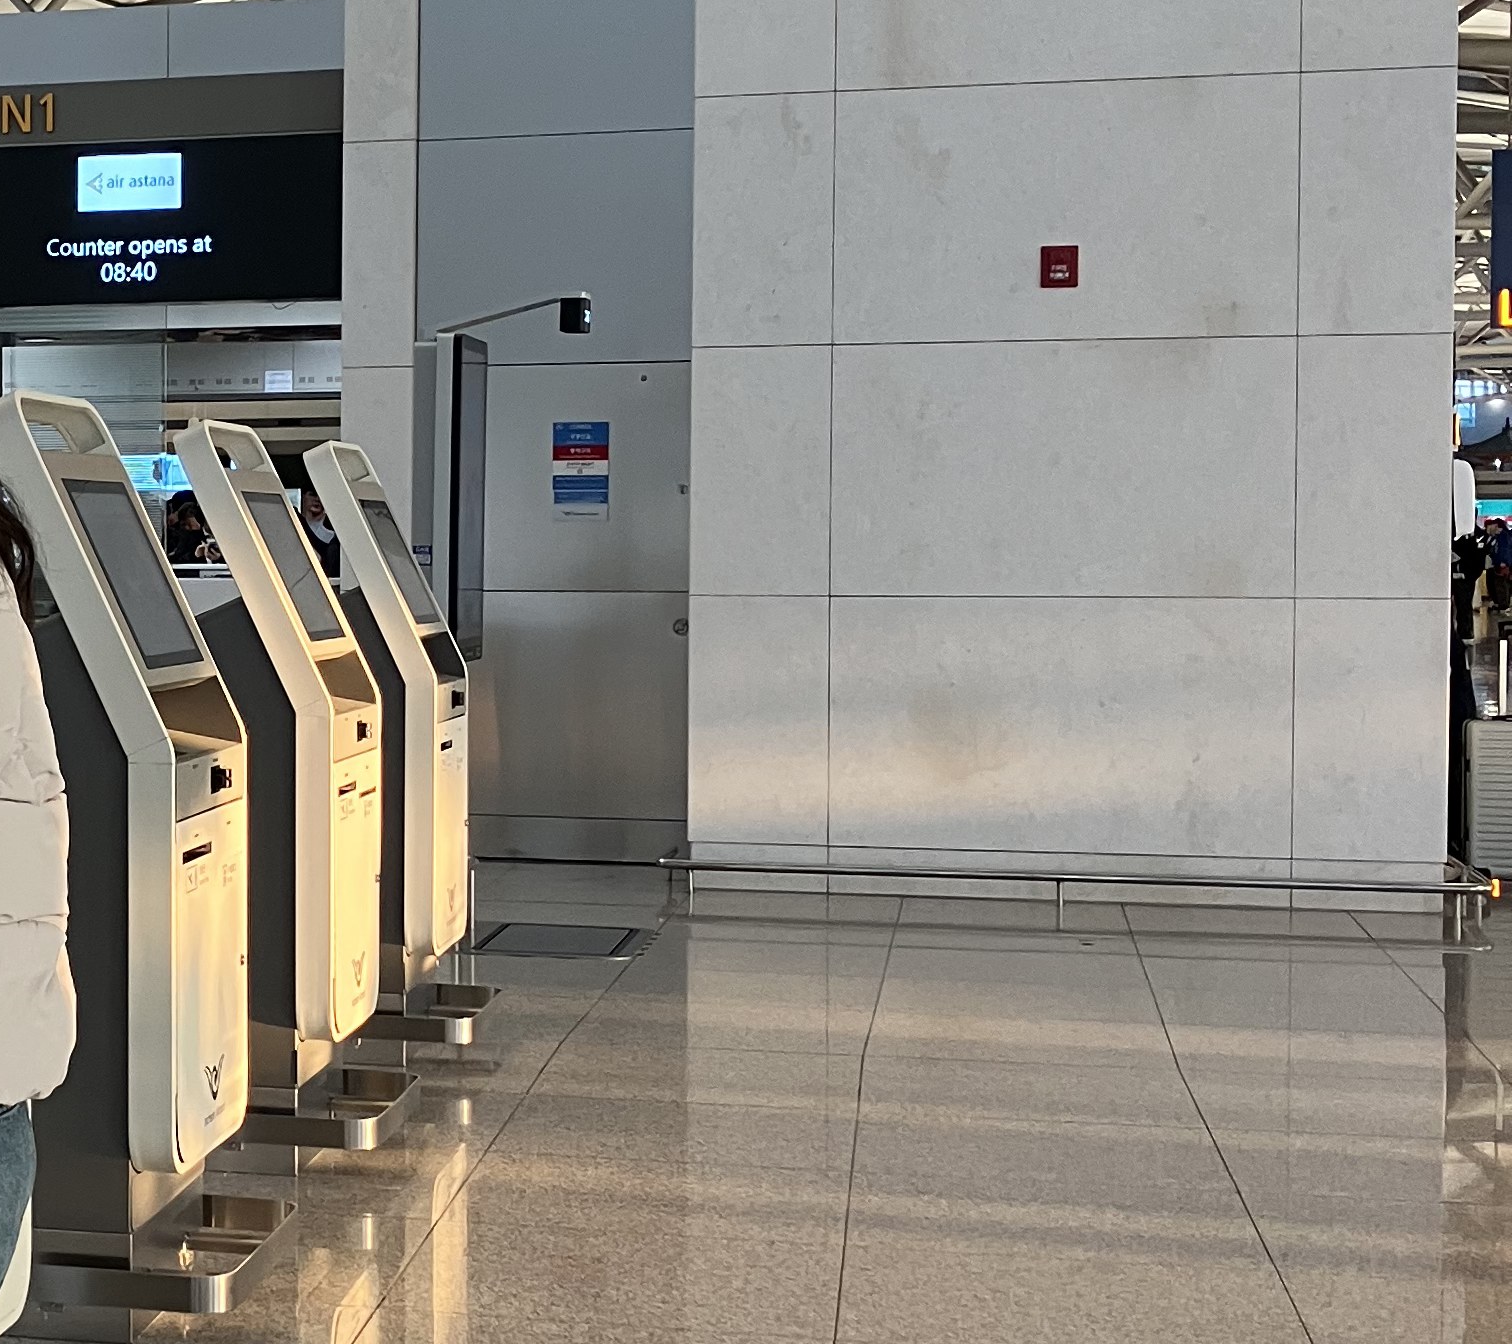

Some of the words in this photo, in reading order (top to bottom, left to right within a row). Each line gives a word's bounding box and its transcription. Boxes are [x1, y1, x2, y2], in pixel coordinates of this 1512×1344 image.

[0, 92, 55, 135] N1
[107, 174, 124, 188] air
[128, 175, 175, 188] astana
[46, 238, 124, 257] Counter
[128, 238, 187, 259] opens
[192, 235, 212, 253] at
[100, 261, 157, 283] 08:40
